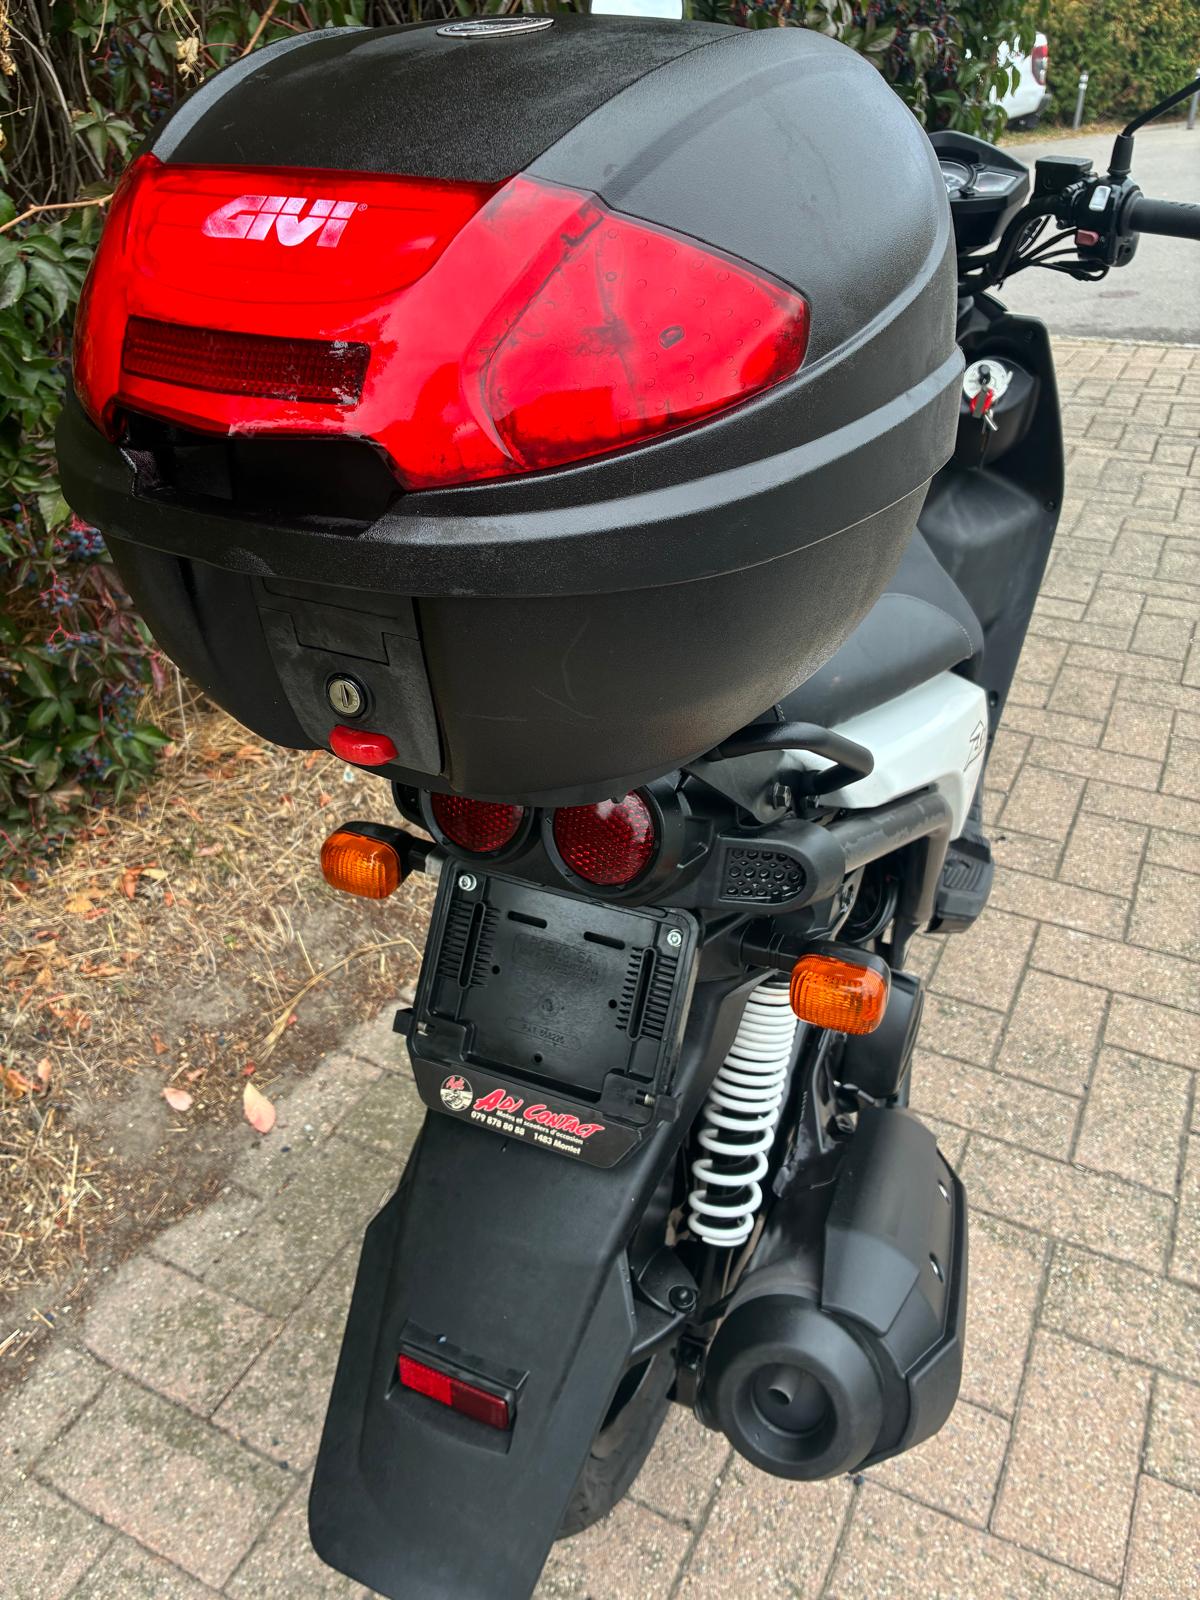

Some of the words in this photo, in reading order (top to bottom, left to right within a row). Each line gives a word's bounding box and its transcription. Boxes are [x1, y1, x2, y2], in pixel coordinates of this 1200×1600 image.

[201, 194, 359, 248] GIVI
[471, 1110, 486, 1122] 079
[534, 1132, 553, 1145] 1483
[553, 1139, 581, 1155] Montet
[496, 1110, 515, 1122] Motos
[523, 1121, 549, 1133] scooters
[550, 1129, 584, 1145] d'occasion
[523, 1104, 605, 1138] CONTACT
